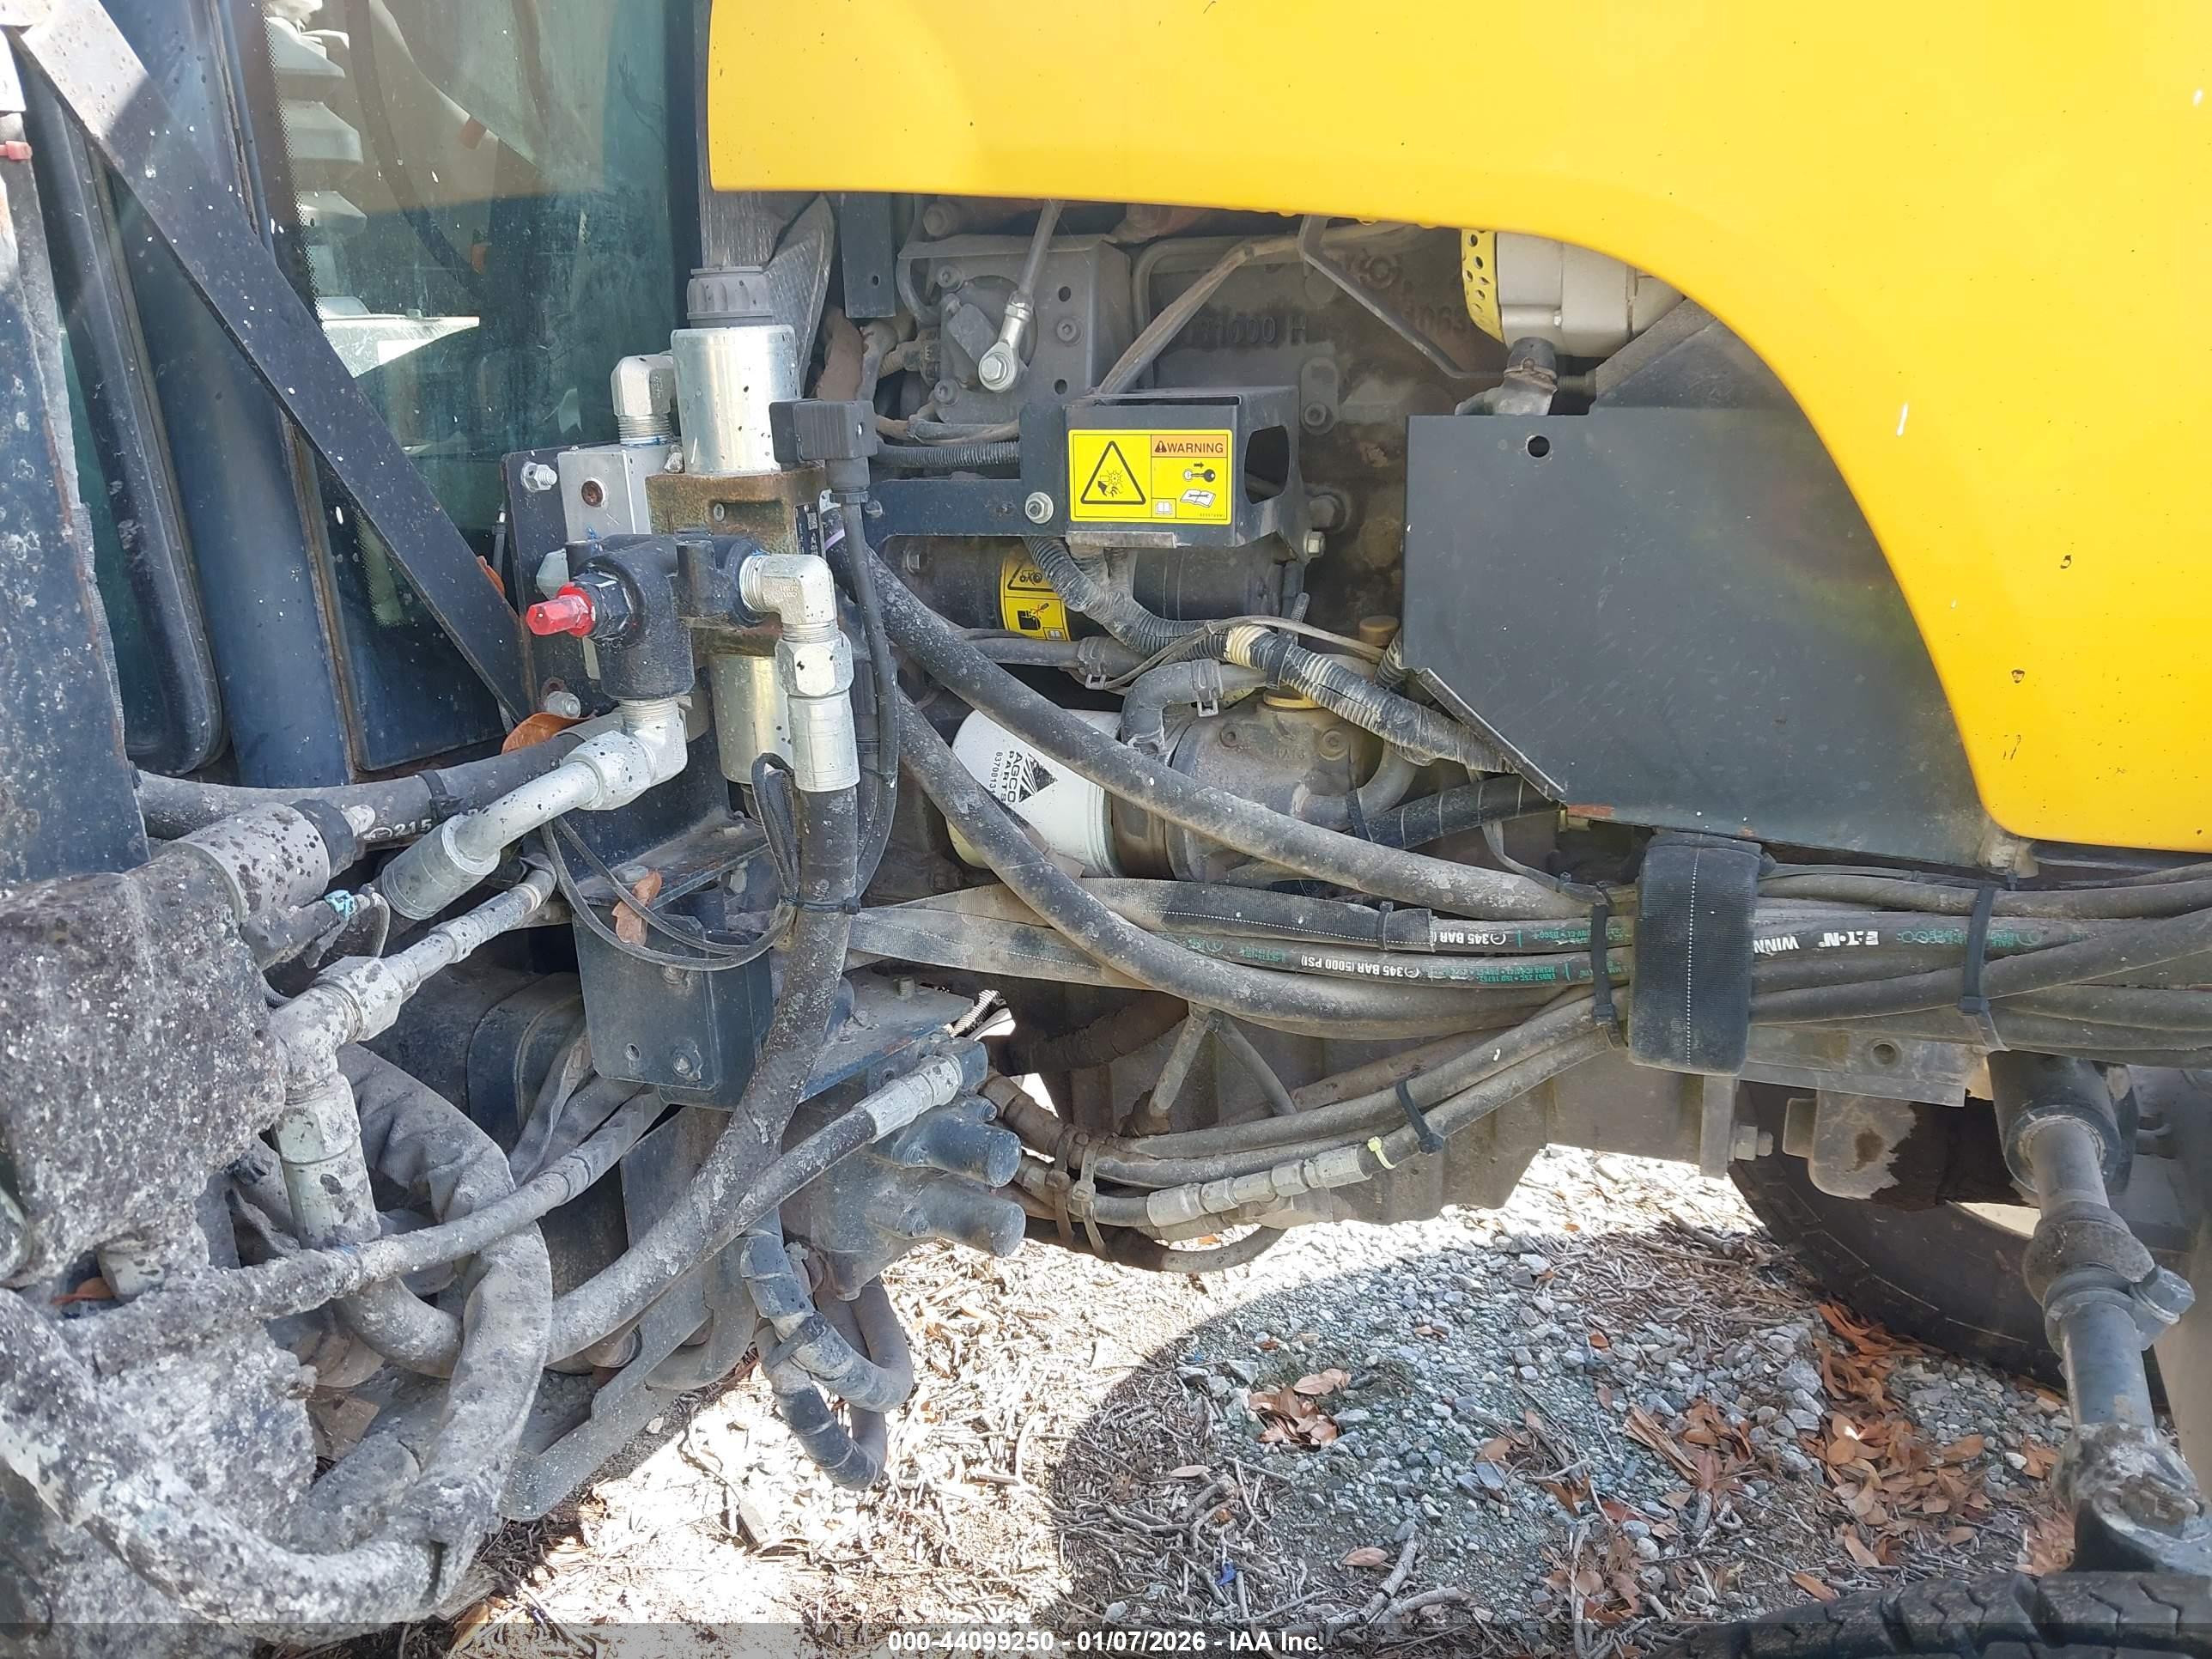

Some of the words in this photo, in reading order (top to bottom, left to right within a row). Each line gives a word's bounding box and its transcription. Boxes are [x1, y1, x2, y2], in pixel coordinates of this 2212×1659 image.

[1167, 442, 1224, 453] WARNING
[1000, 750, 1015, 802] PARTS
[1007, 751, 1023, 803] AGCO
[394, 817, 433, 836] 215
[1439, 932, 1465, 944] BAR
[1468, 933, 1490, 945] 345
[1301, 954, 1323, 969] PSI)
[1325, 957, 1355, 972] (5000
[1357, 962, 1381, 975] BAR
[1382, 964, 1404, 977] 345
